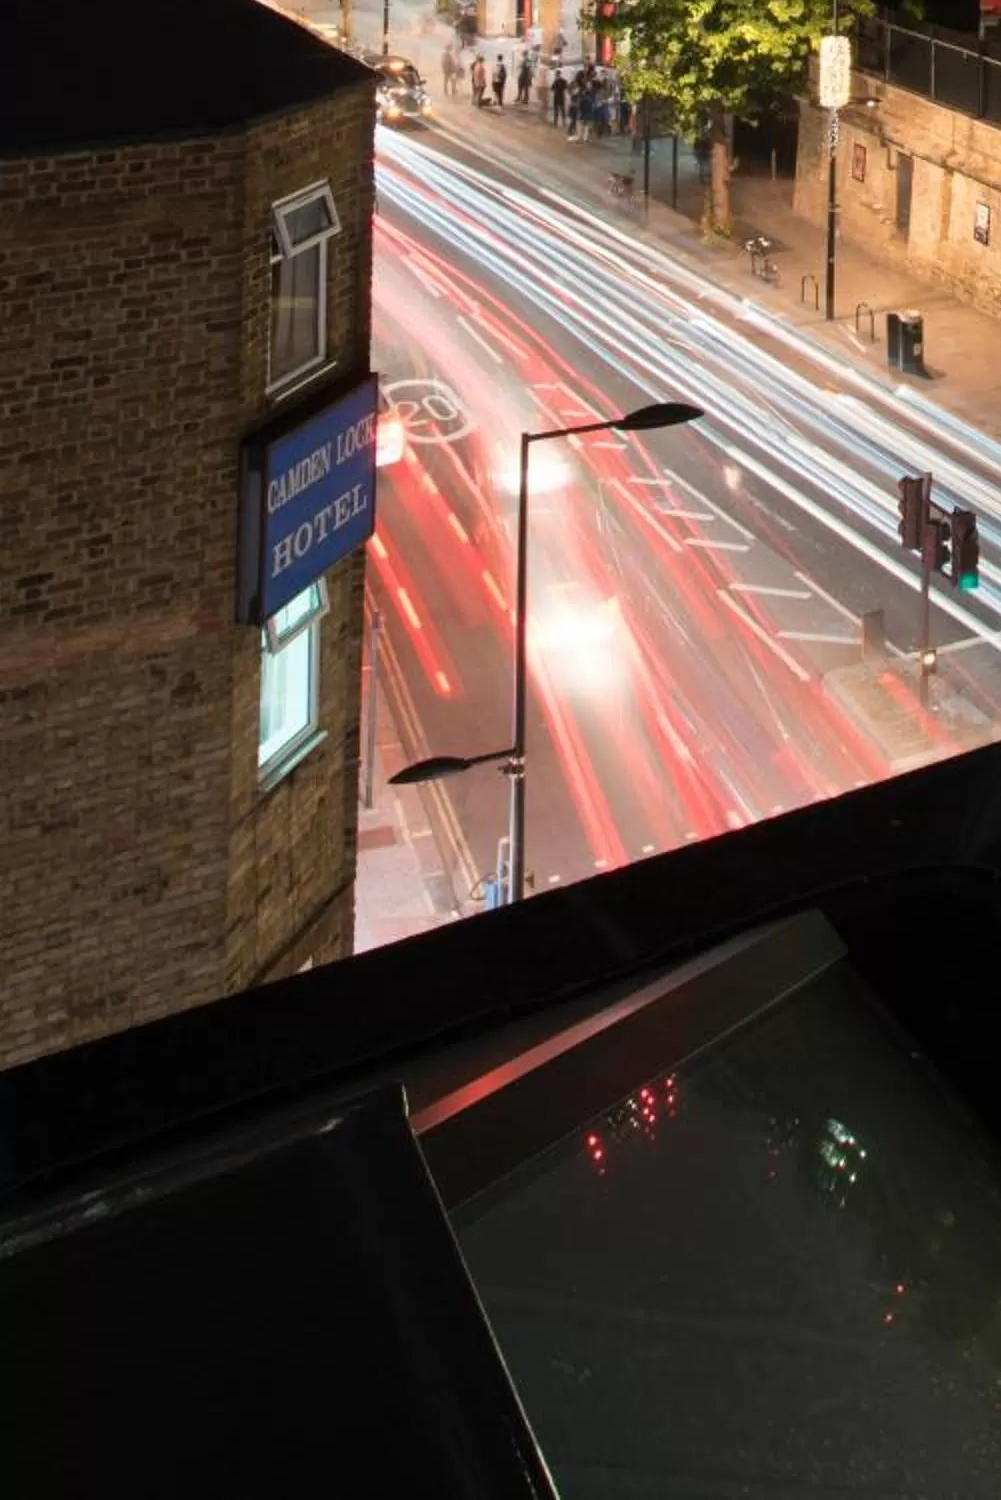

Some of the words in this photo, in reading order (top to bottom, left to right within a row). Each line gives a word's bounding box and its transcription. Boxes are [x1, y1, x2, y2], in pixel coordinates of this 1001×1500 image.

[395, 395, 458, 427] 20
[267, 440, 332, 513] CAMDEN
[335, 412, 376, 466] LOCK
[271, 483, 367, 578] HOTEL
